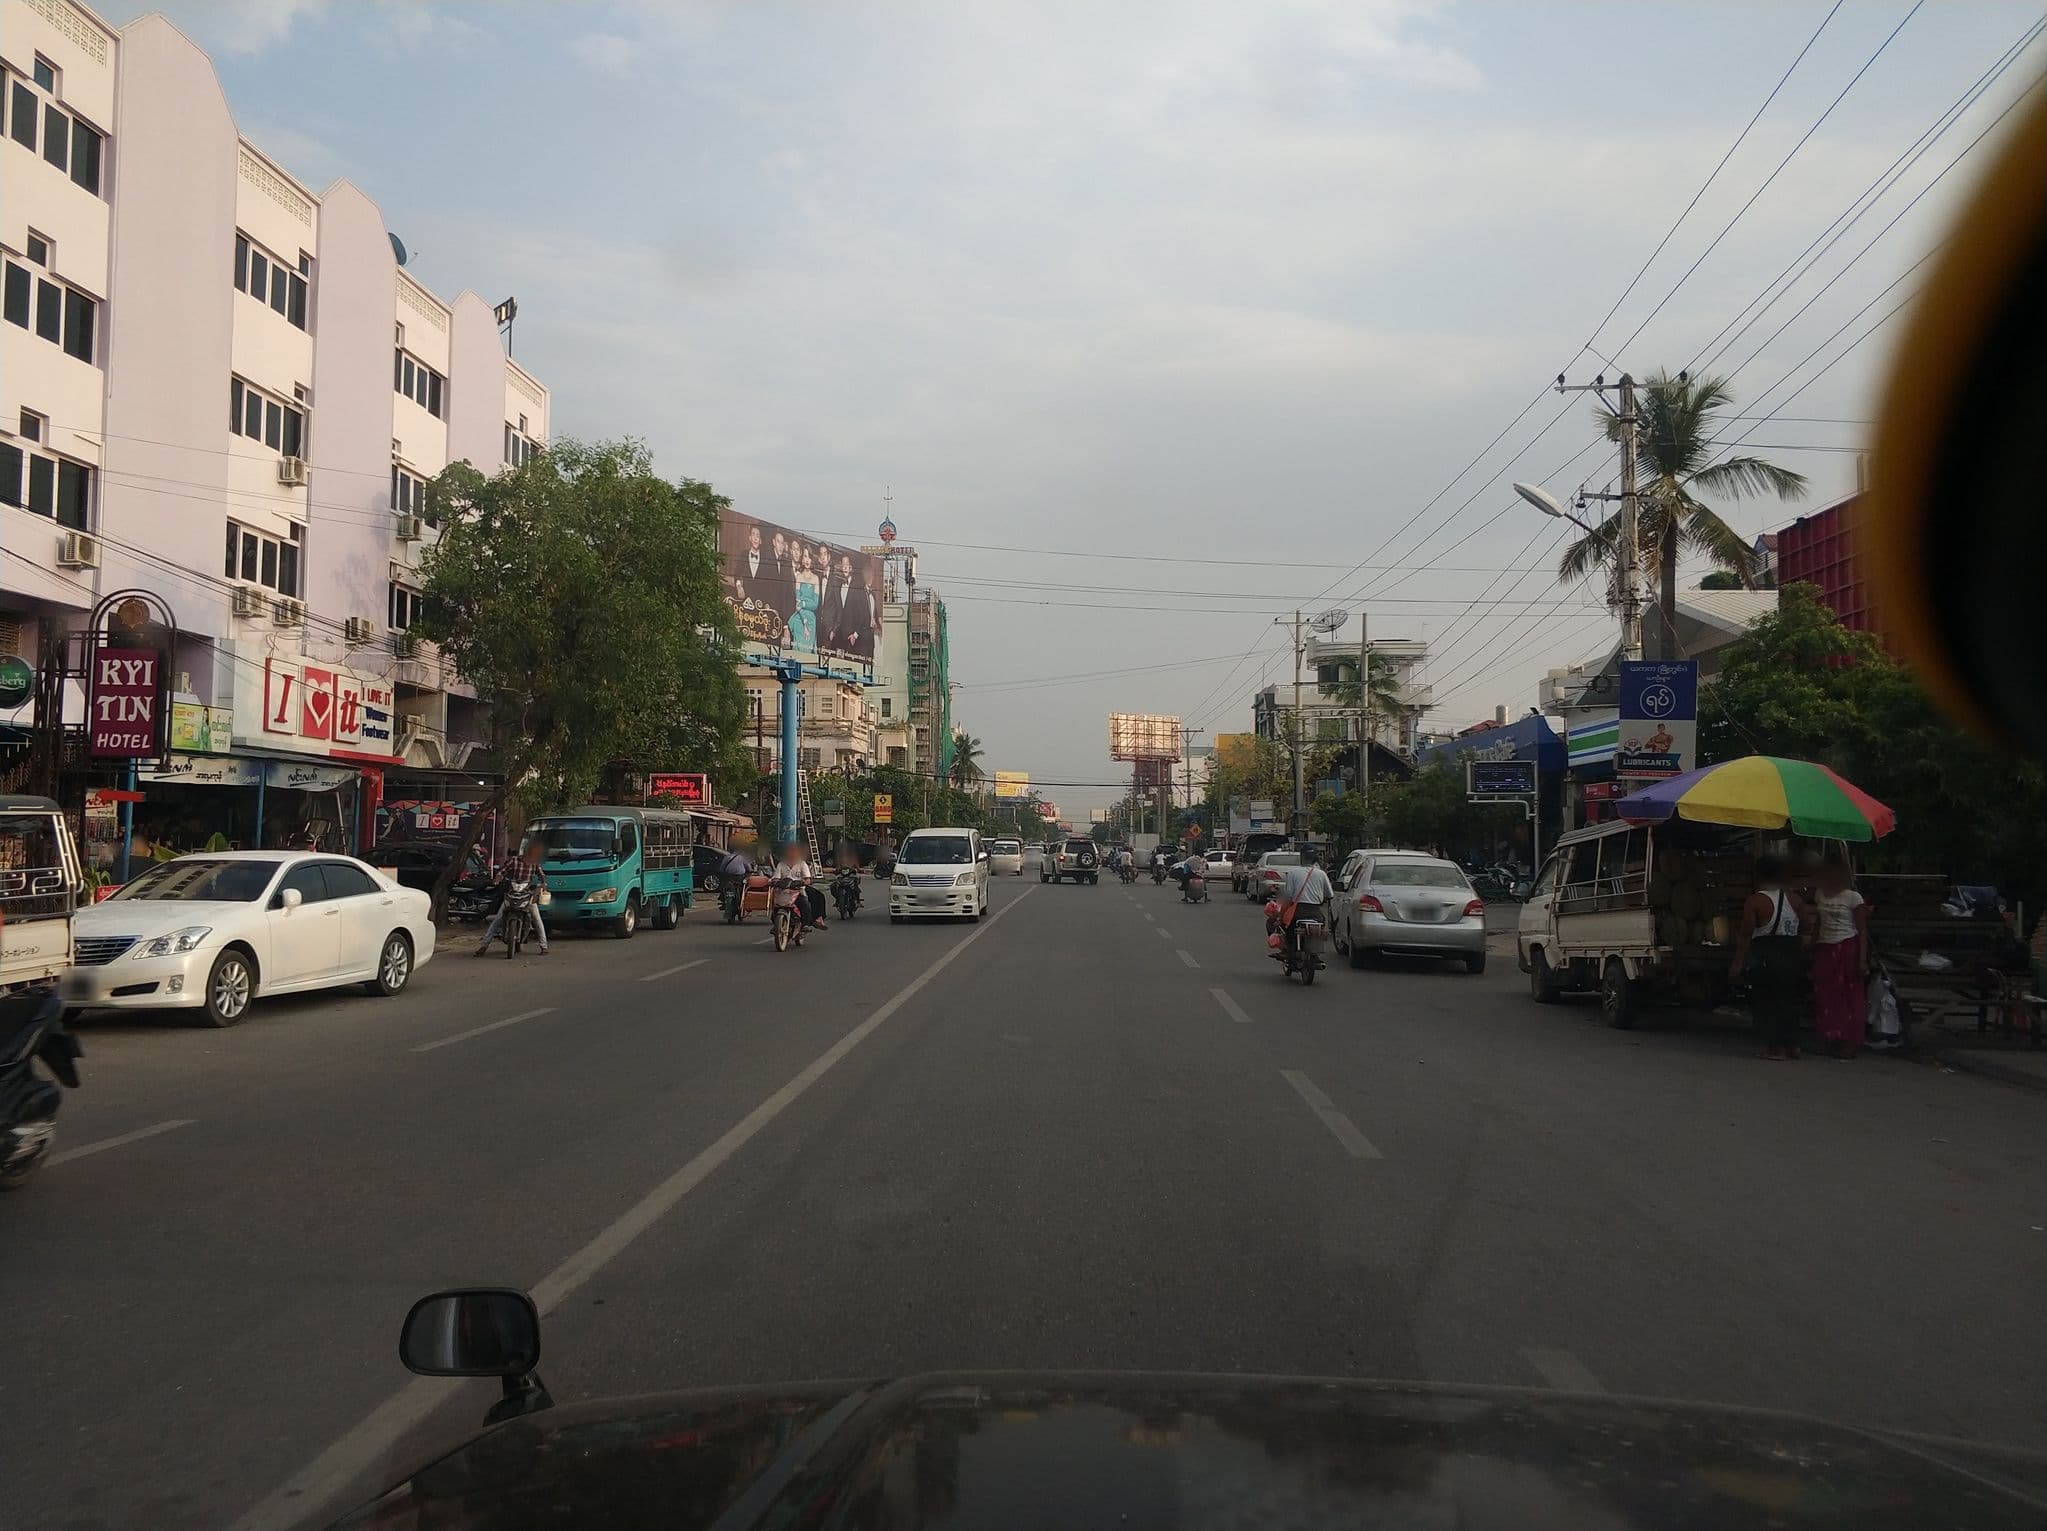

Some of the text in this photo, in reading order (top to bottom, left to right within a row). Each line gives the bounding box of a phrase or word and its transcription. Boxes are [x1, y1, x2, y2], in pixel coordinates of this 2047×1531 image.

[0, 674, 26, 688] berg
[99, 659, 154, 686] KYI
[274, 674, 296, 724] I
[367, 688, 382, 705] LOVE
[1646, 688, 1670, 714] ရပ်
[97, 695, 154, 722] TIN
[362, 723, 389, 740] Footwear
[97, 733, 151, 749] HOTEL
[1623, 759, 1672, 767] LUBRICANTS
